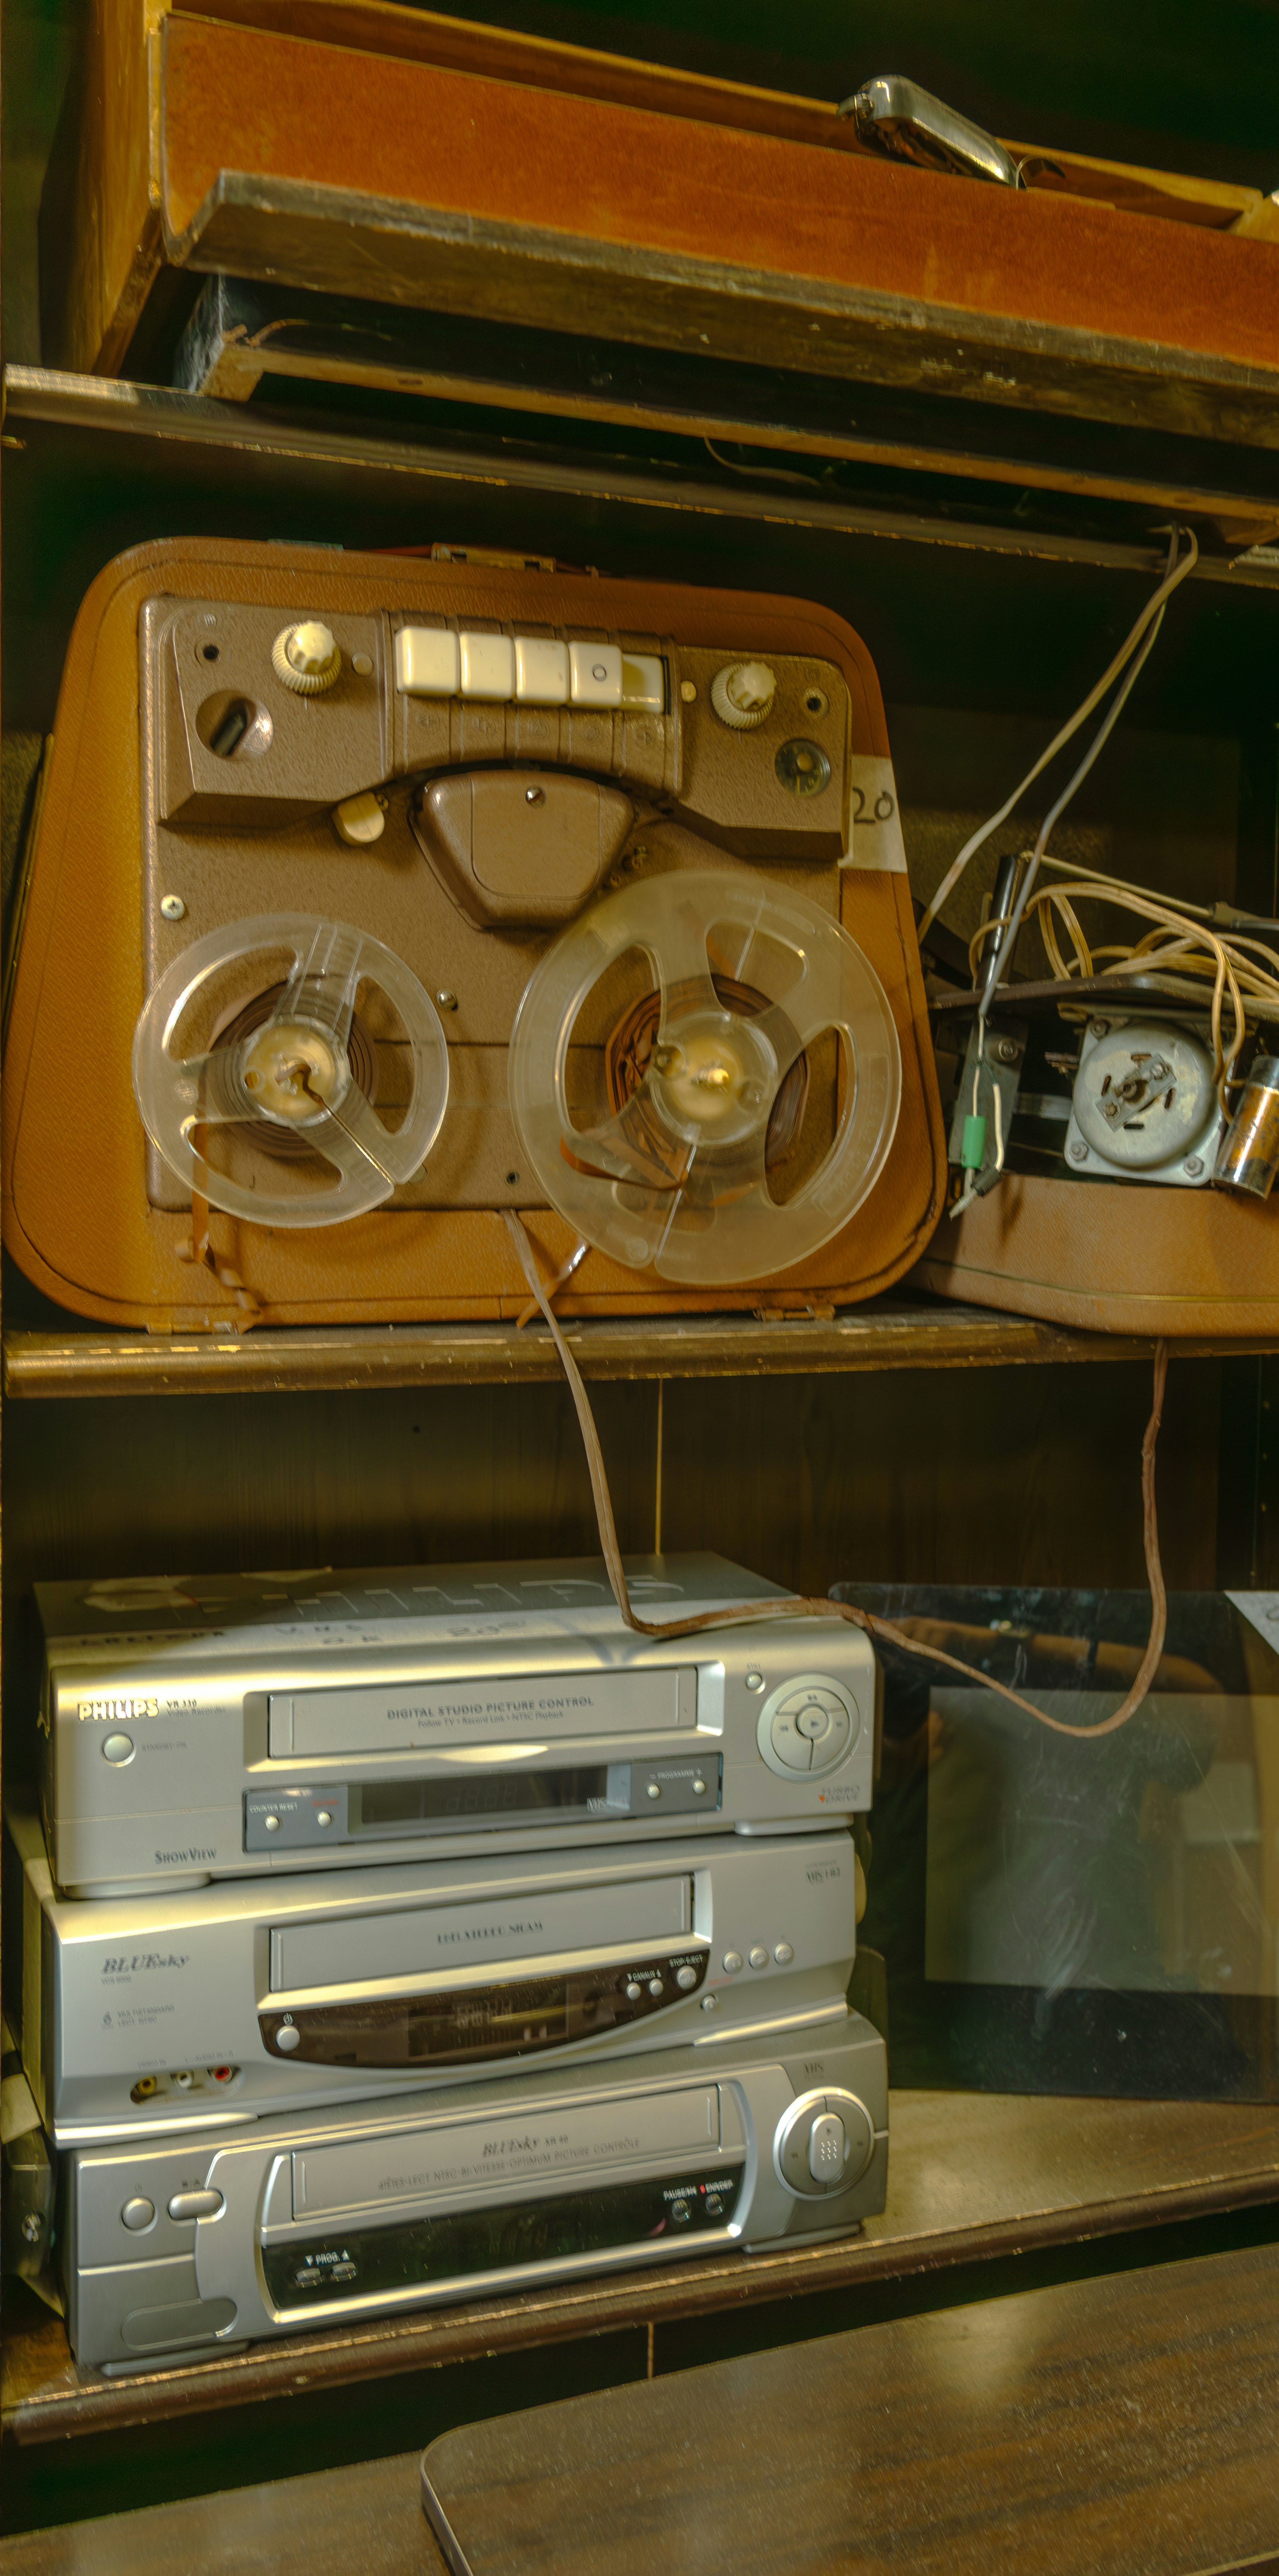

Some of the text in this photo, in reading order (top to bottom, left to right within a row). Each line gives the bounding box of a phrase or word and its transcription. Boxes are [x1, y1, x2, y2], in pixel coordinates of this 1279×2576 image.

[853, 786, 894, 823] 20
[78, 1699, 159, 1721] PHILIPS
[166, 1705, 226, 1717] Video Recorder
[387, 1696, 594, 1720] DIGITAL STUDIO PICTURE CONTROL
[417, 1709, 564, 1729] Follow TV Record Link NTSC Playback
[657, 1768, 695, 1780] PROGRAMME
[249, 1801, 298, 1813] COUNTER RESET
[101, 1953, 190, 1975] BLUEsky
[669, 1953, 703, 1968] STOP/EJECT
[632, 1970, 656, 1981] CANAUX
[315, 2251, 340, 2266] PROG
